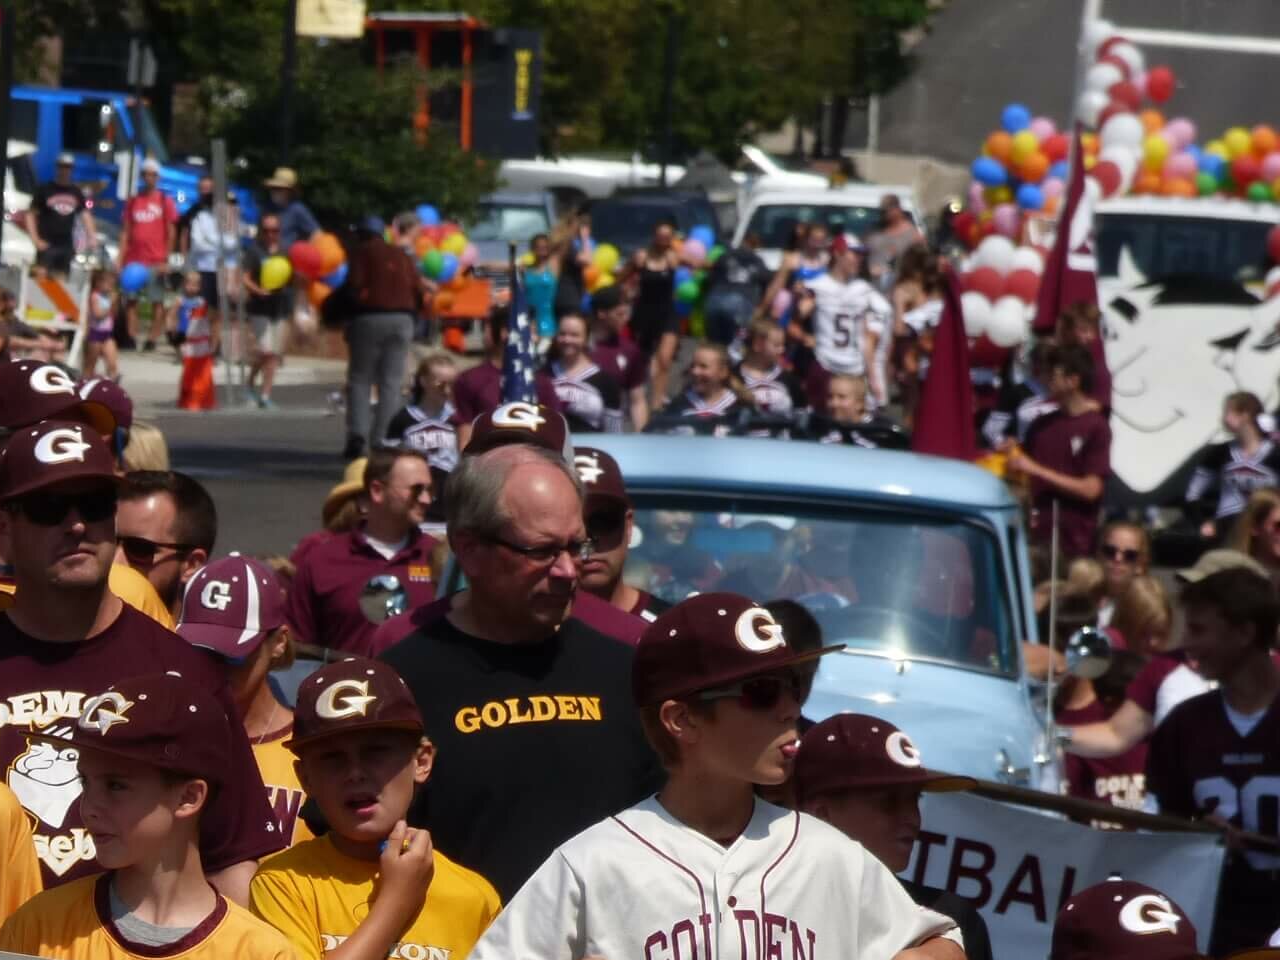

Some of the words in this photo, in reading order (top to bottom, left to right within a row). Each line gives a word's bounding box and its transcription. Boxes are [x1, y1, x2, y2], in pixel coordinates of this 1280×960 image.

[201, 580, 232, 611] G
[735, 607, 786, 654] G
[315, 680, 377, 719] G
[455, 696, 602, 734] GOLDEN
[1119, 894, 1181, 935] G
